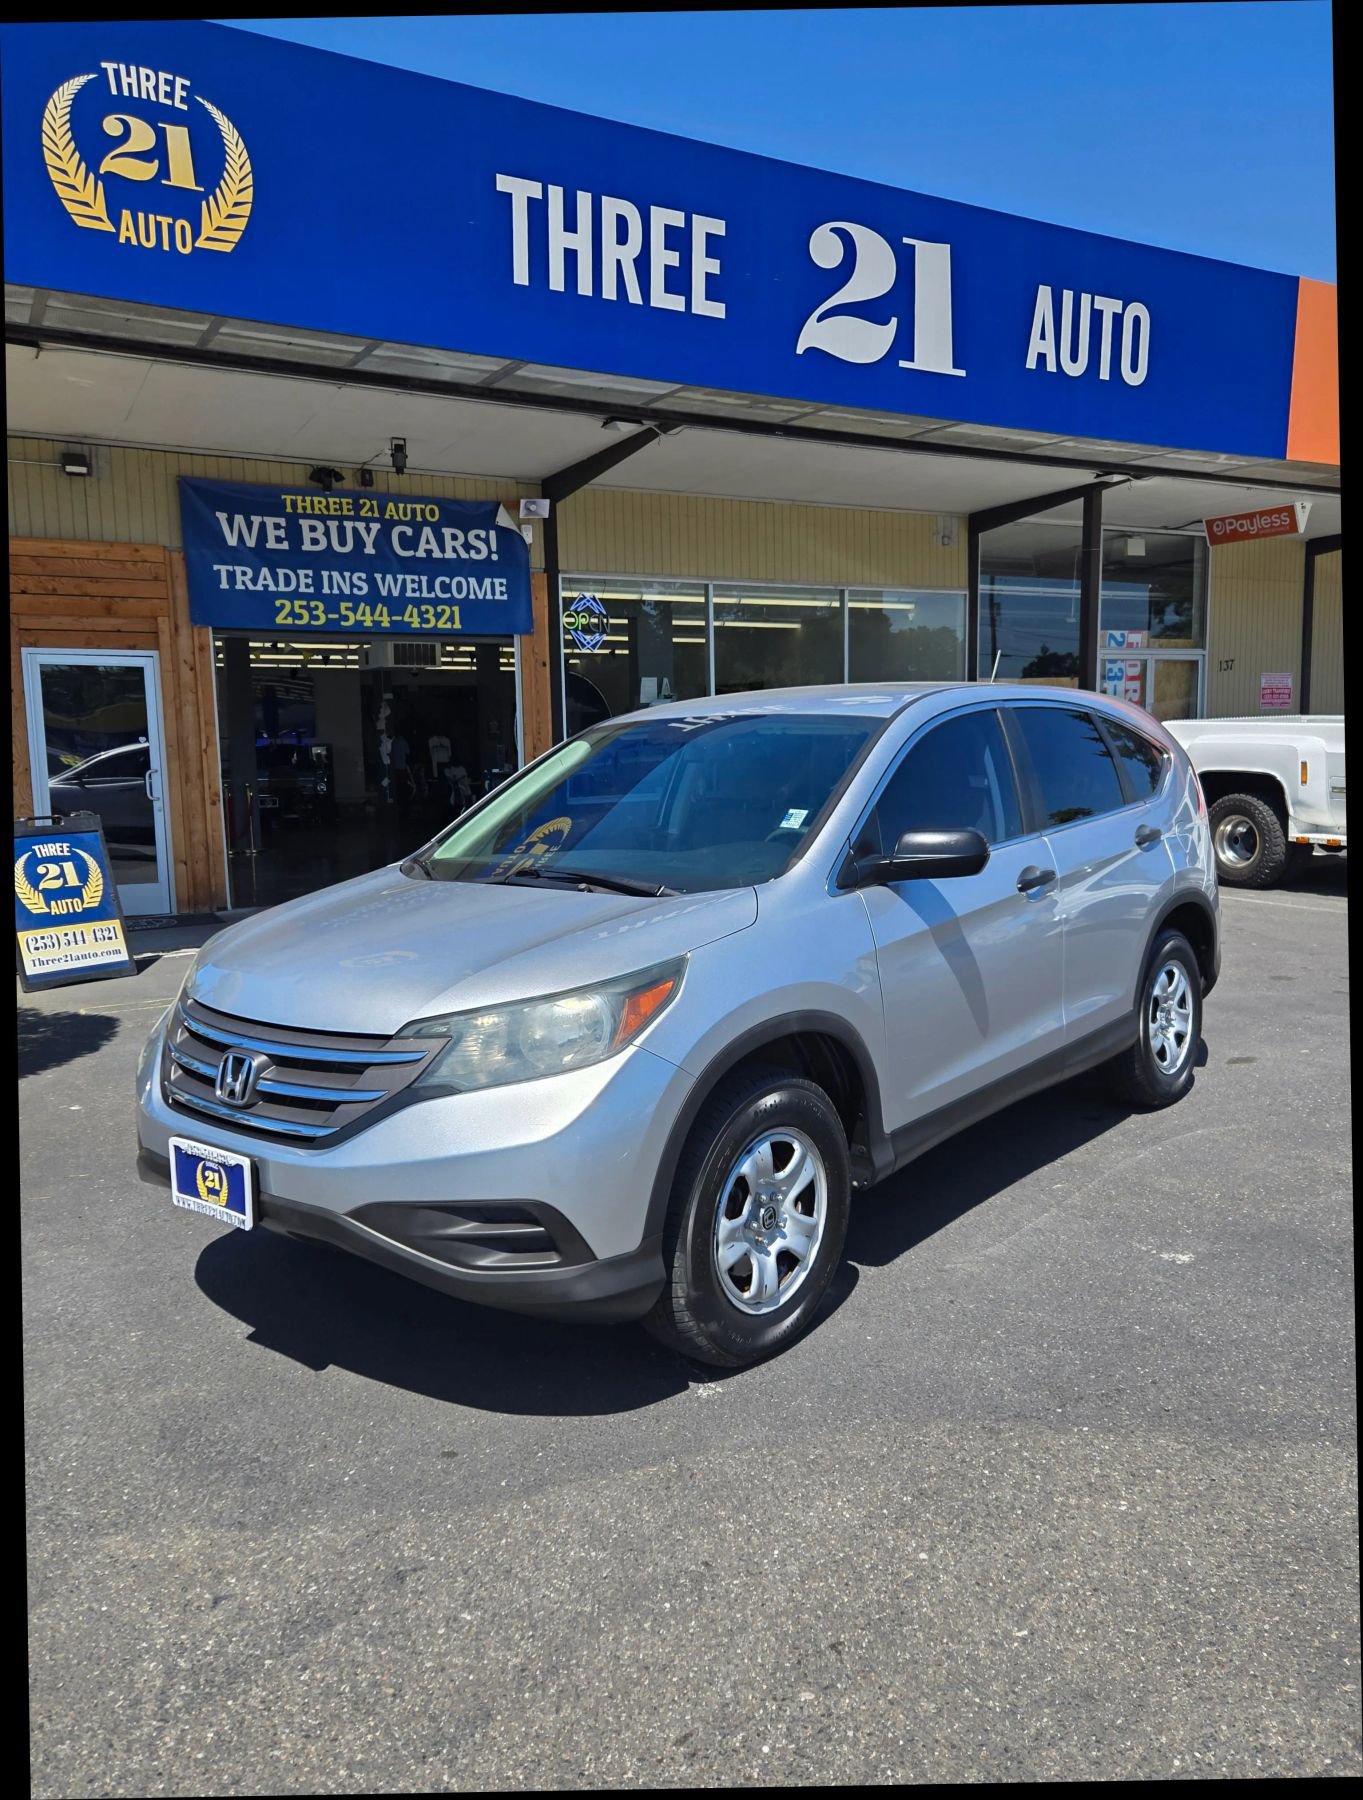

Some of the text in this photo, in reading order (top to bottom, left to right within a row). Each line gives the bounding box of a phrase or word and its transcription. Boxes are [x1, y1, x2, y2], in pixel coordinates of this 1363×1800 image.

[100, 62, 191, 111] THREE
[99, 114, 204, 191] 21
[119, 209, 193, 254] AUTO
[495, 173, 1151, 387] THREE 21 AUTO
[281, 494, 440, 522] THREE 21 AUTO
[215, 511, 499, 561] WE BUY CARS!
[213, 564, 508, 600] TRADE INS WELCOME
[275, 599, 462, 629] 253-544-4321
[32, 843, 71, 858] THREE
[36, 861, 83, 890] 21
[50, 898, 83, 915] AUTO
[25, 932, 61, 954] (253)
[30, 948, 122, 968] Three21auto.com
[204, 1170, 221, 1191] 21
